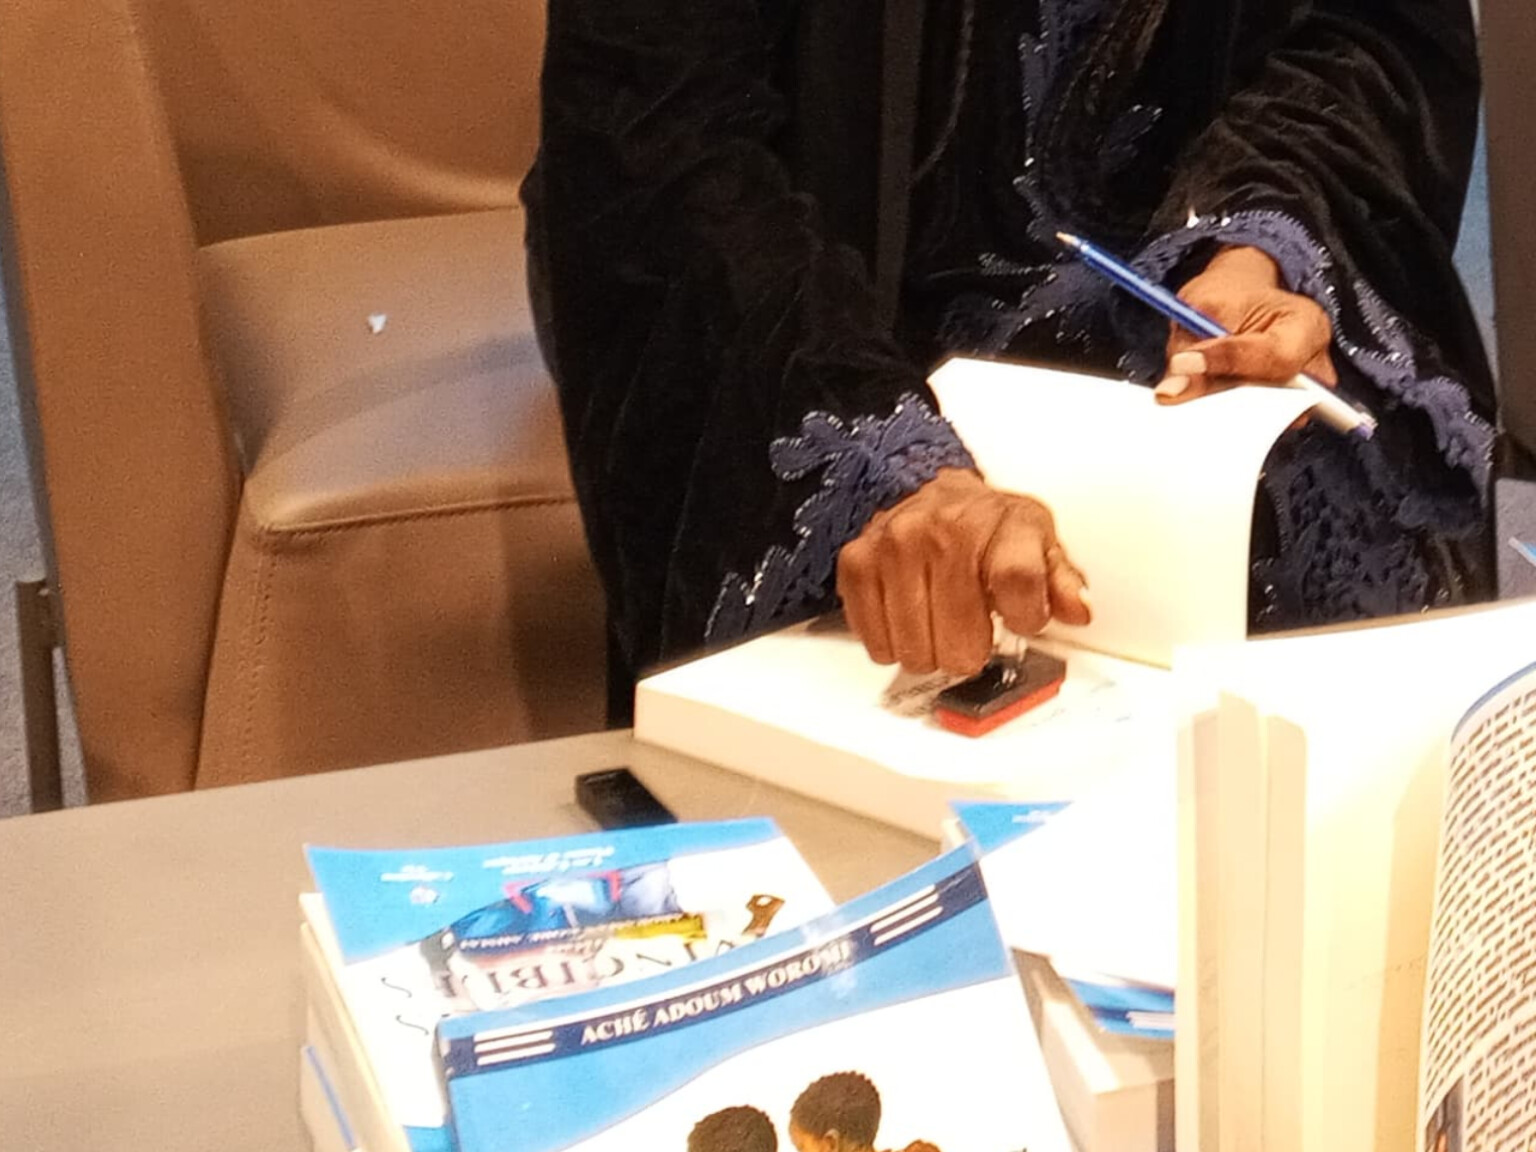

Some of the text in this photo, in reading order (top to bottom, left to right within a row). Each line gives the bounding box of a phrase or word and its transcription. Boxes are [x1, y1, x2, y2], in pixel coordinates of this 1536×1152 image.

[581, 939, 851, 1046] ACHÉ ADOUM WOROMI
